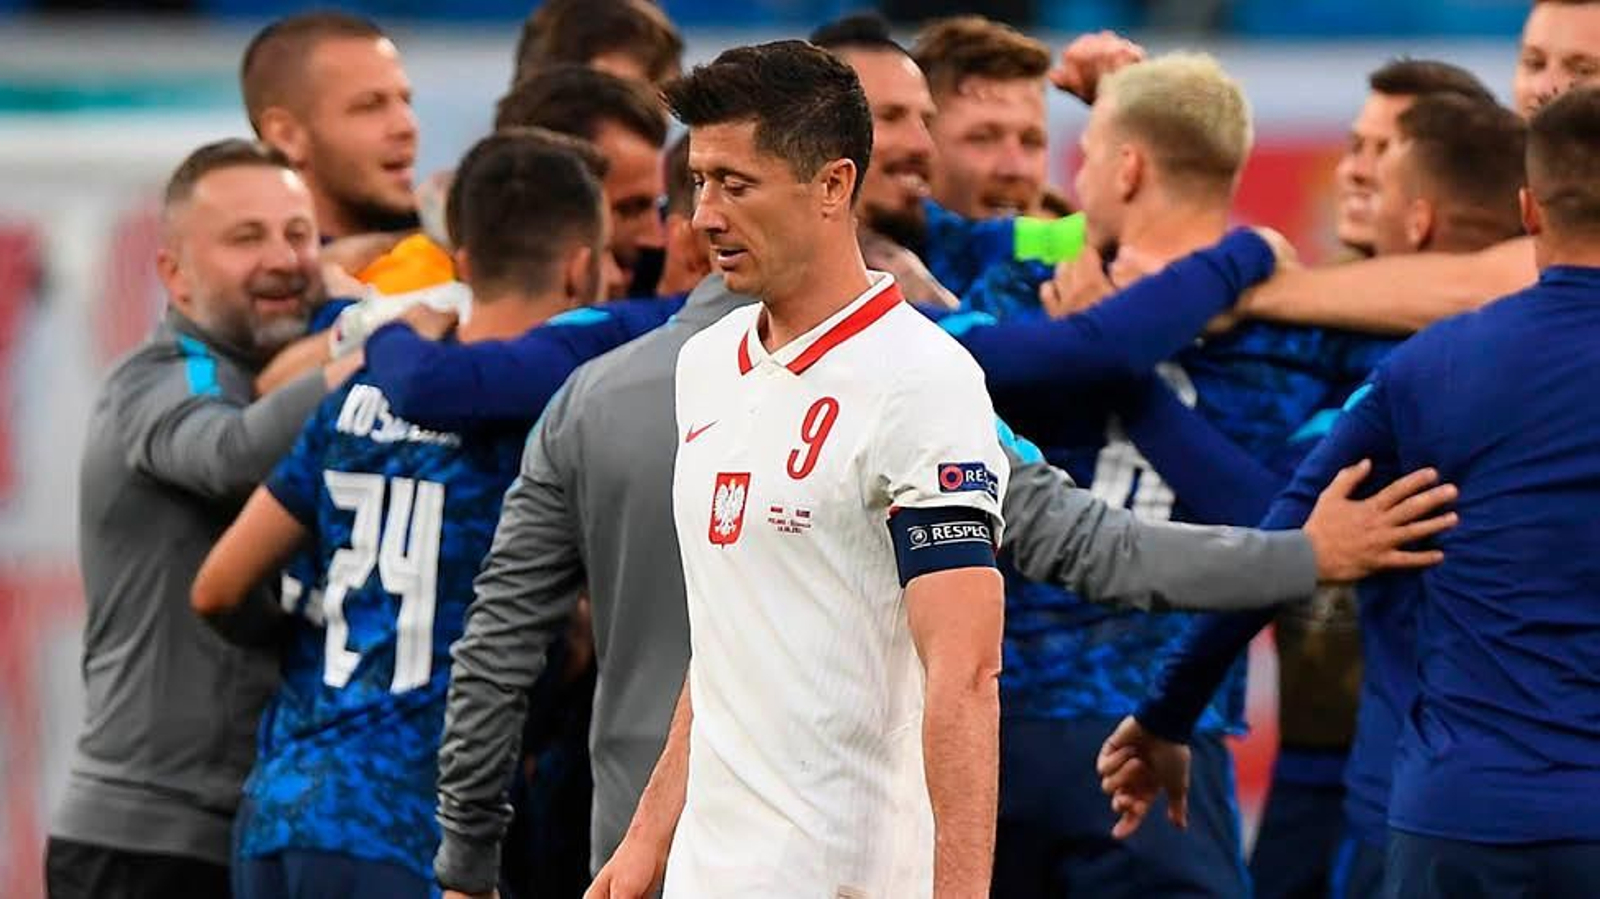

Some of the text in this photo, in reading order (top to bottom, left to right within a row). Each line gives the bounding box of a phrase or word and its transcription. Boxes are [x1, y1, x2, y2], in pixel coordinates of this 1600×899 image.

[787, 396, 840, 480] 9
[931, 524, 991, 541] RESPEC
[323, 469, 445, 694] 24
